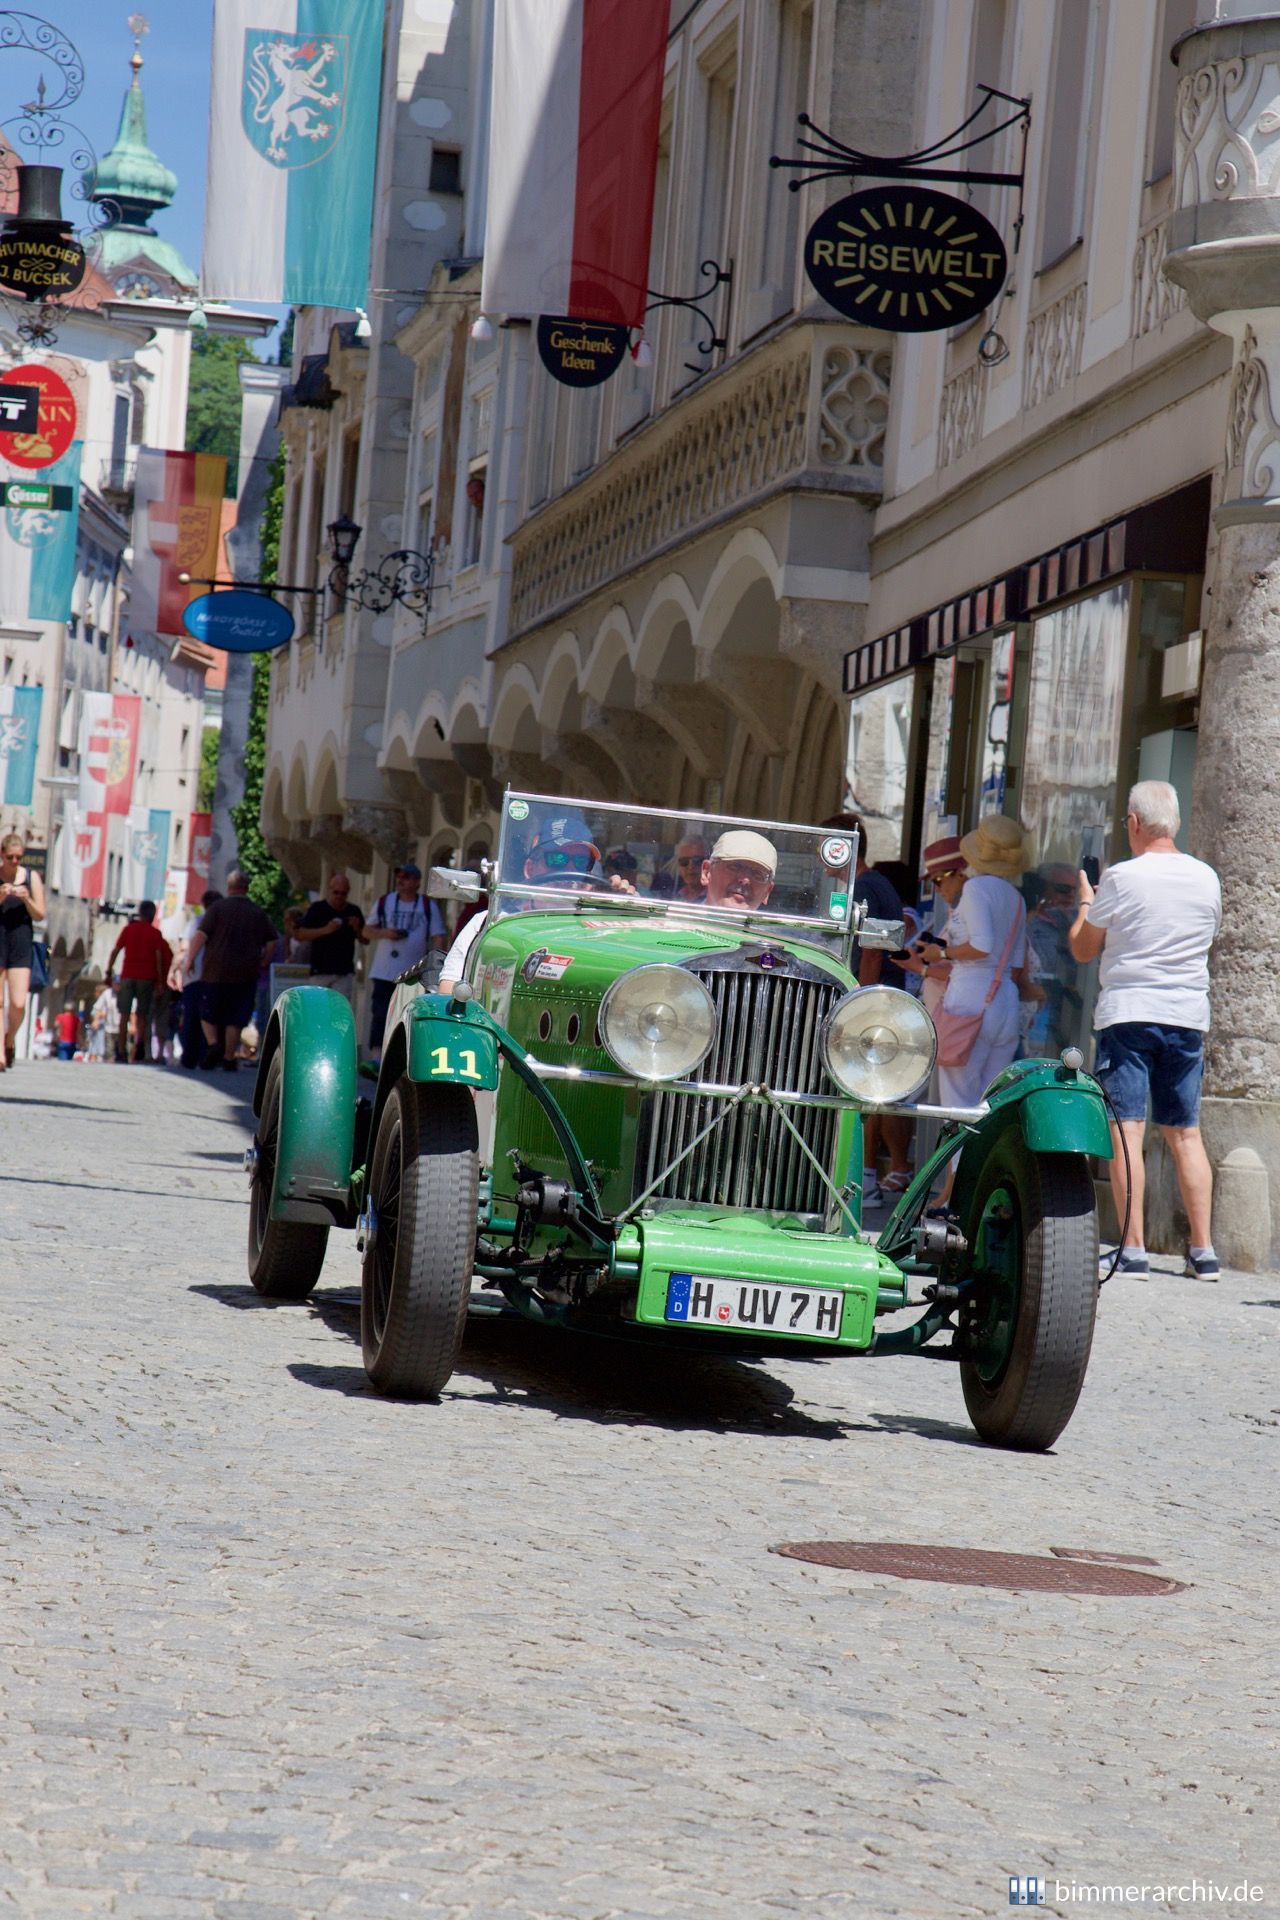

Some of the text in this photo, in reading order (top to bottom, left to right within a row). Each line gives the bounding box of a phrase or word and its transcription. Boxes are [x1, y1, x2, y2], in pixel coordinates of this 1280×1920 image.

[0, 242, 80, 266] HUTMACHER
[812, 239, 1002, 280] REISEWELT
[13, 268, 73, 286] BUCSEK
[550, 330, 616, 354] Geschenk-
[561, 351, 596, 370] Ideen
[0, 402, 26, 420] T
[431, 1047, 482, 1080] 11
[673, 1301, 682, 1313] D
[691, 1282, 714, 1318] H
[738, 1287, 781, 1325] UV
